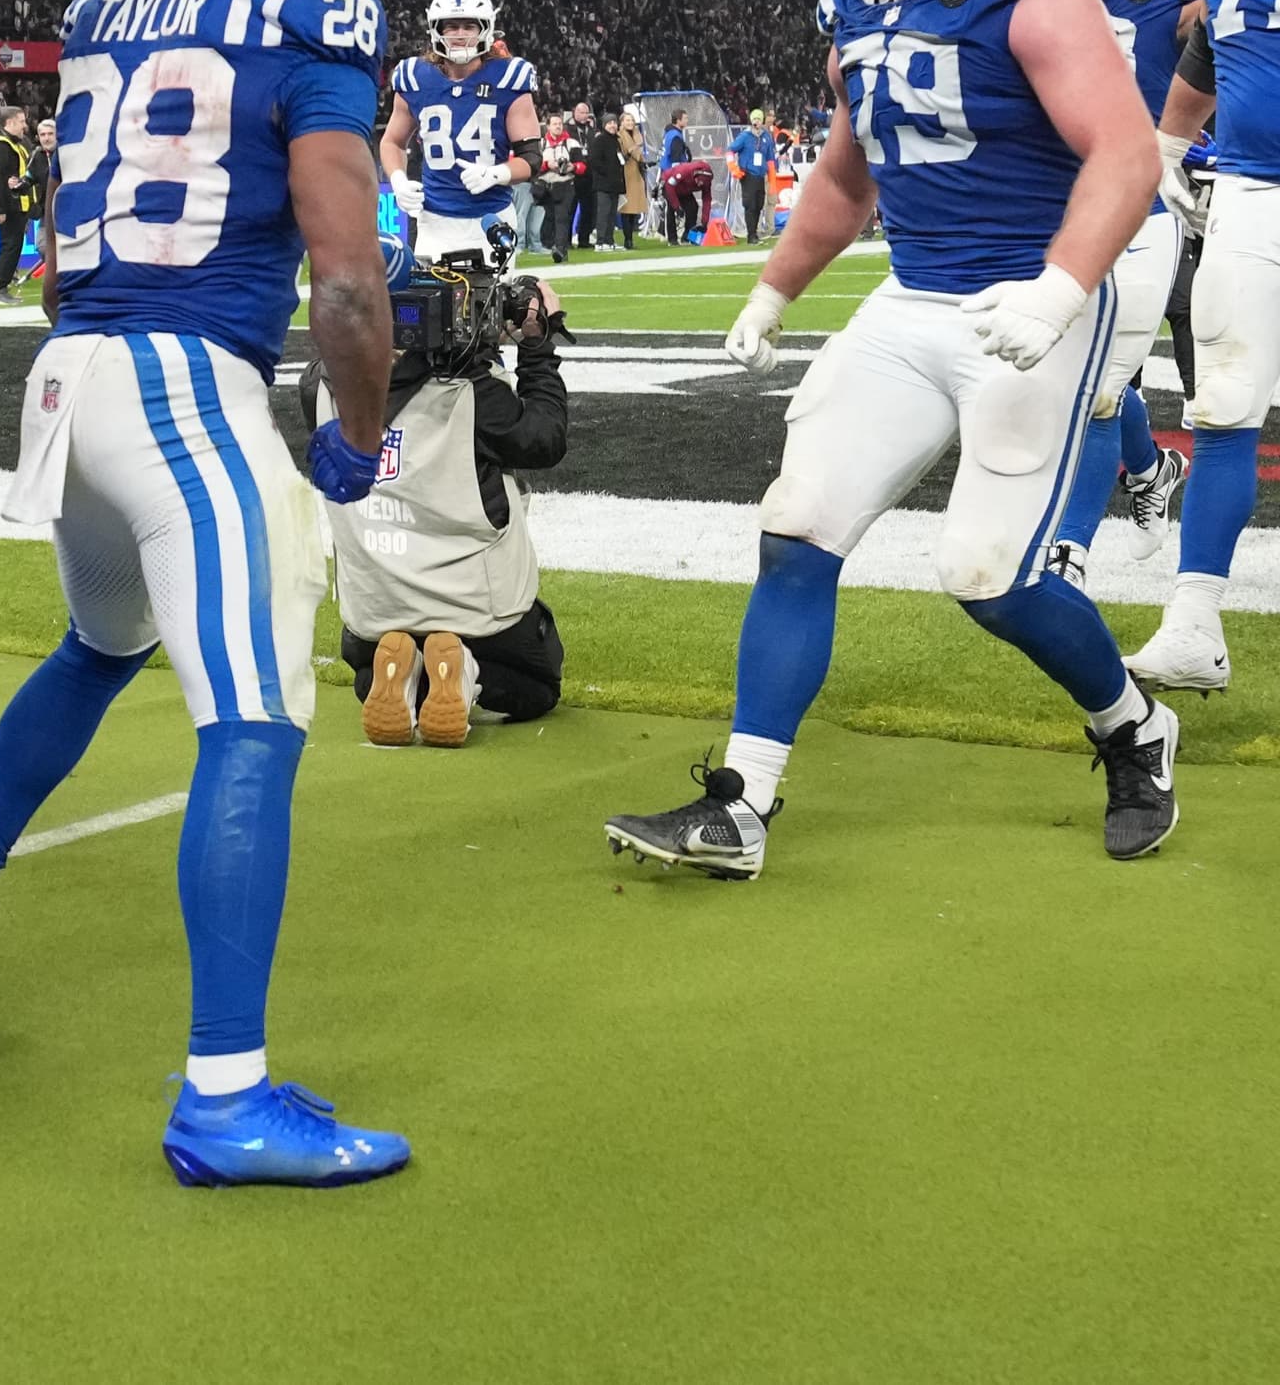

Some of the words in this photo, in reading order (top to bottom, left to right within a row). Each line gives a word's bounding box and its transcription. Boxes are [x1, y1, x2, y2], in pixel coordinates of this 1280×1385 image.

[54, 48, 236, 273] 28
[419, 103, 498, 171] 84
[839, 30, 978, 166] 79
